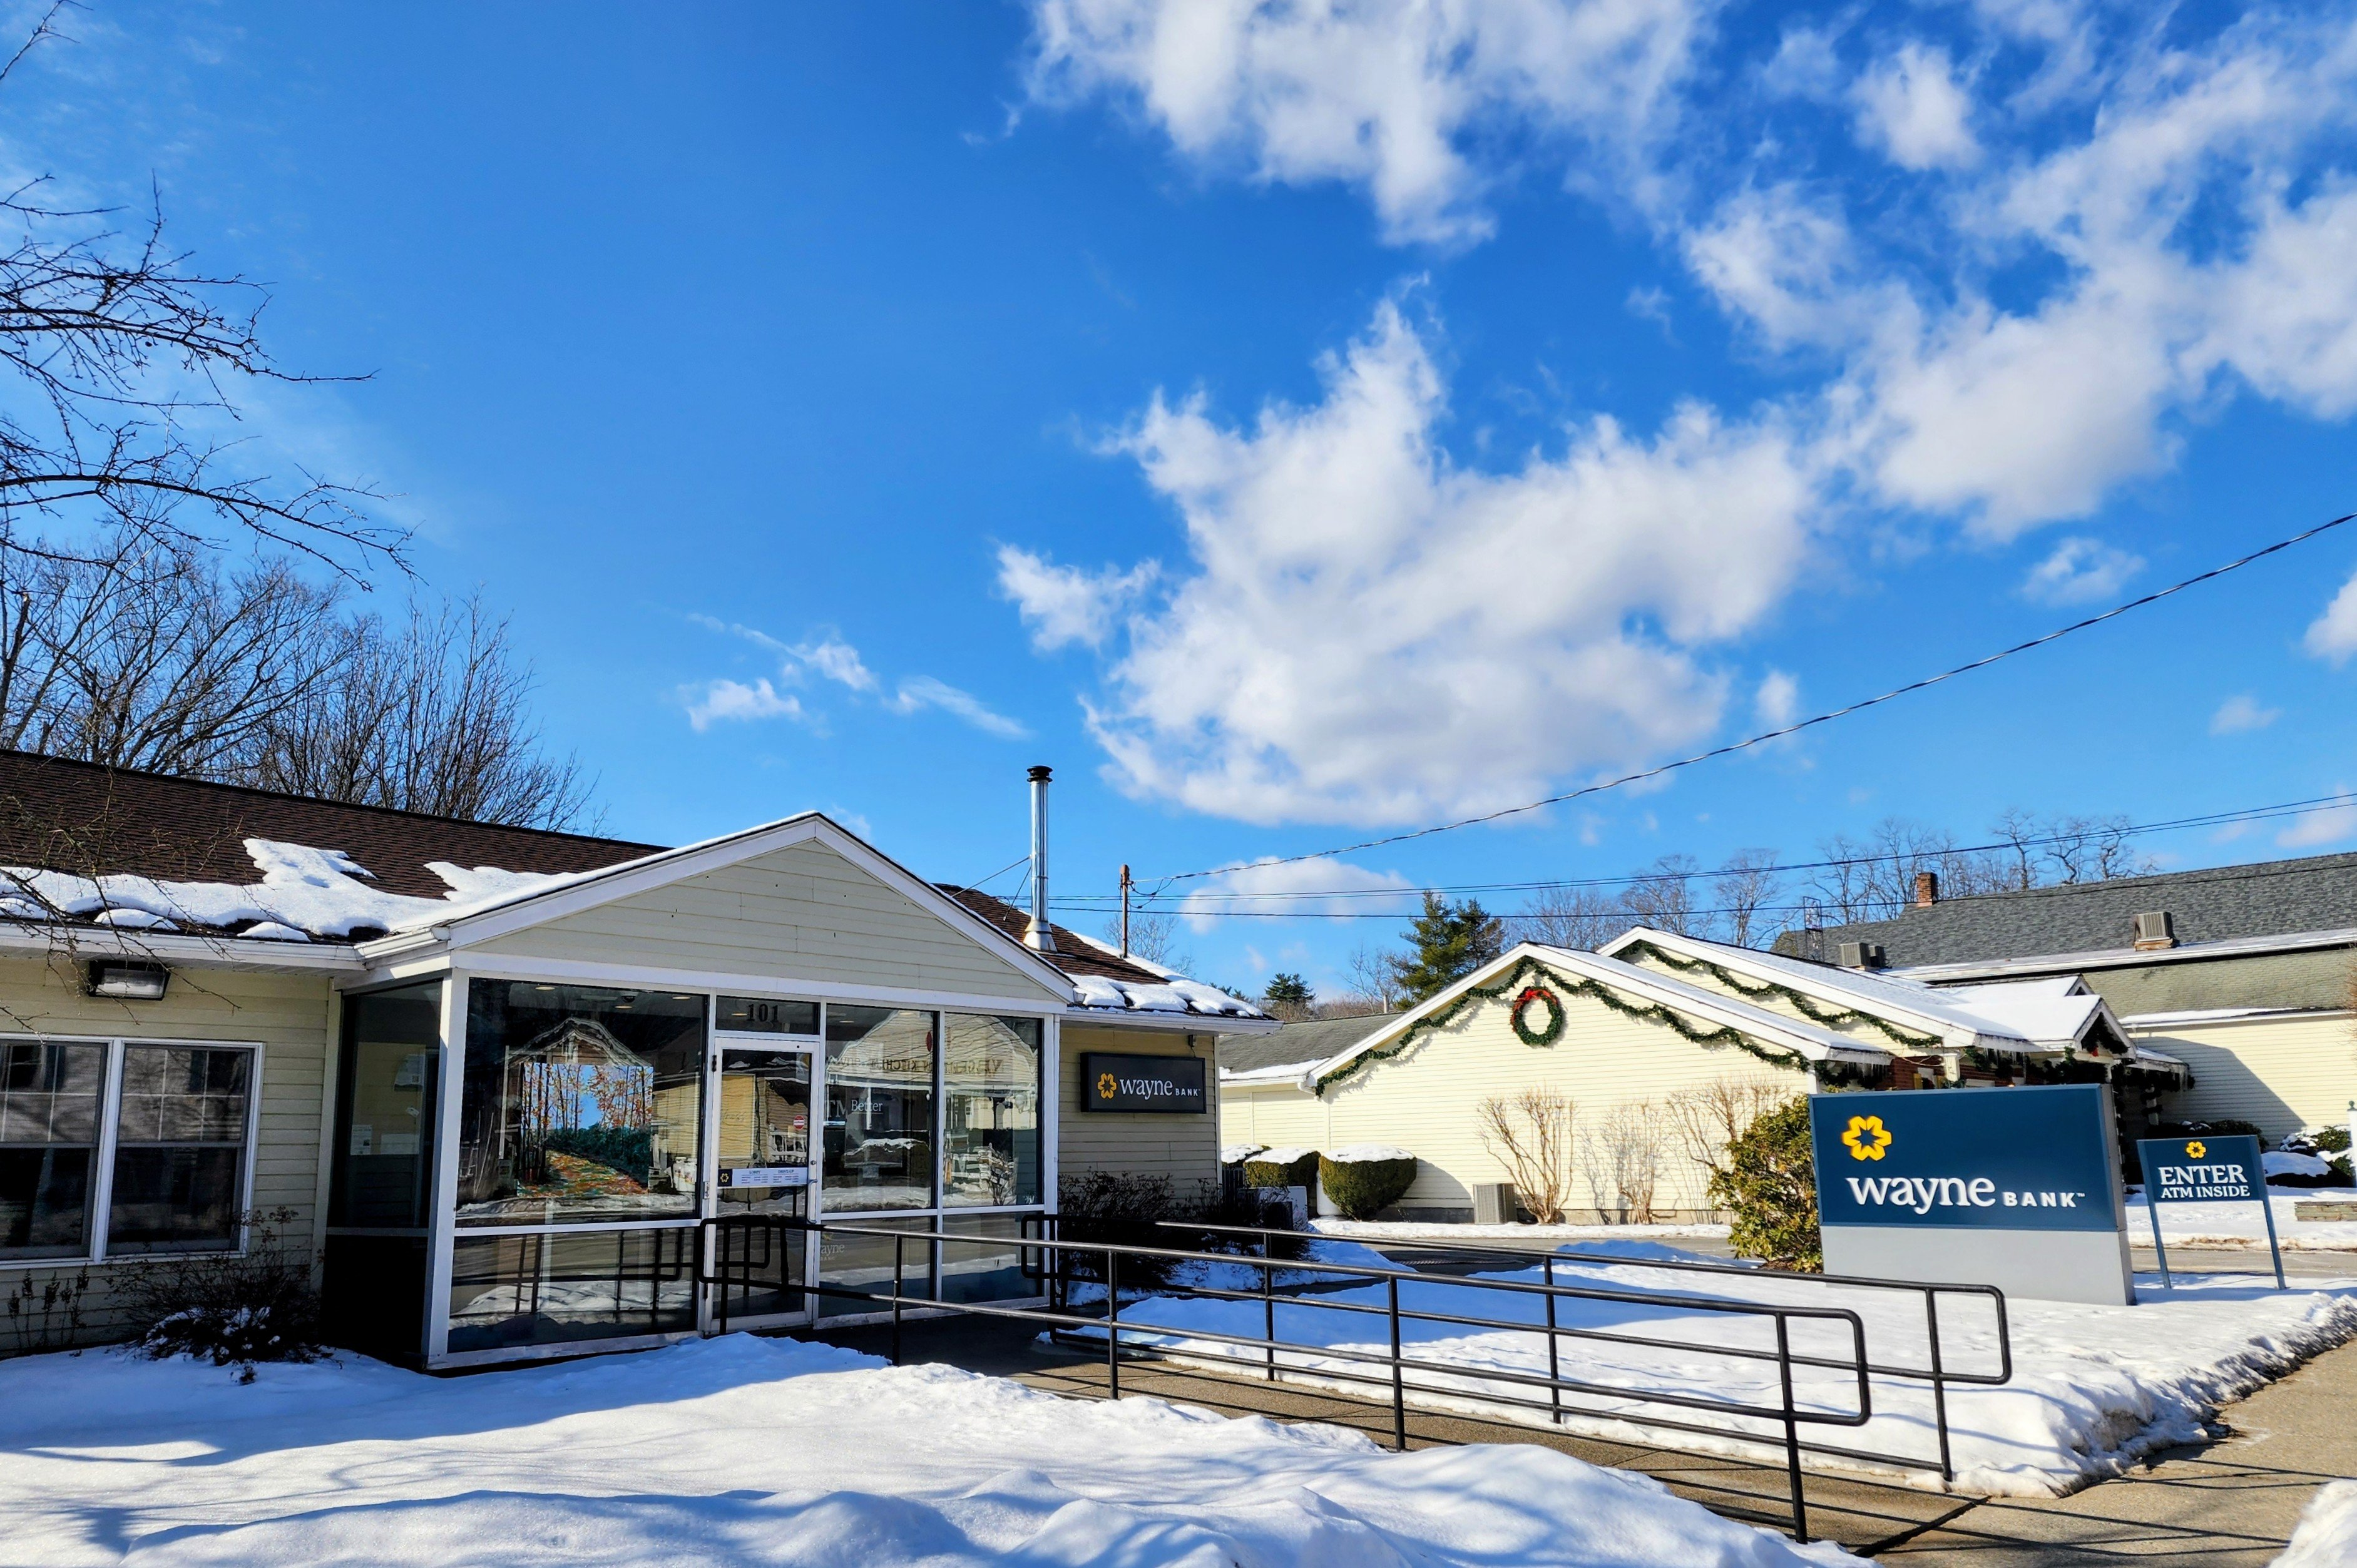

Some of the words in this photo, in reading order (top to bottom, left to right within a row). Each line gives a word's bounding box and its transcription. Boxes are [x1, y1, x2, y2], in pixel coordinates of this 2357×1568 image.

[747, 1003, 780, 1023] 101
[1119, 1079, 1173, 1100] wayne
[824, 1100, 848, 1118] TM
[851, 1099, 883, 1112] Better
[2158, 1164, 2248, 1185] ENTER
[1845, 1177, 1997, 1214] wayne
[2160, 1187, 2194, 1199] ATM
[2197, 1185, 2251, 1198] INSIDE
[821, 1244, 845, 1256] ayne
